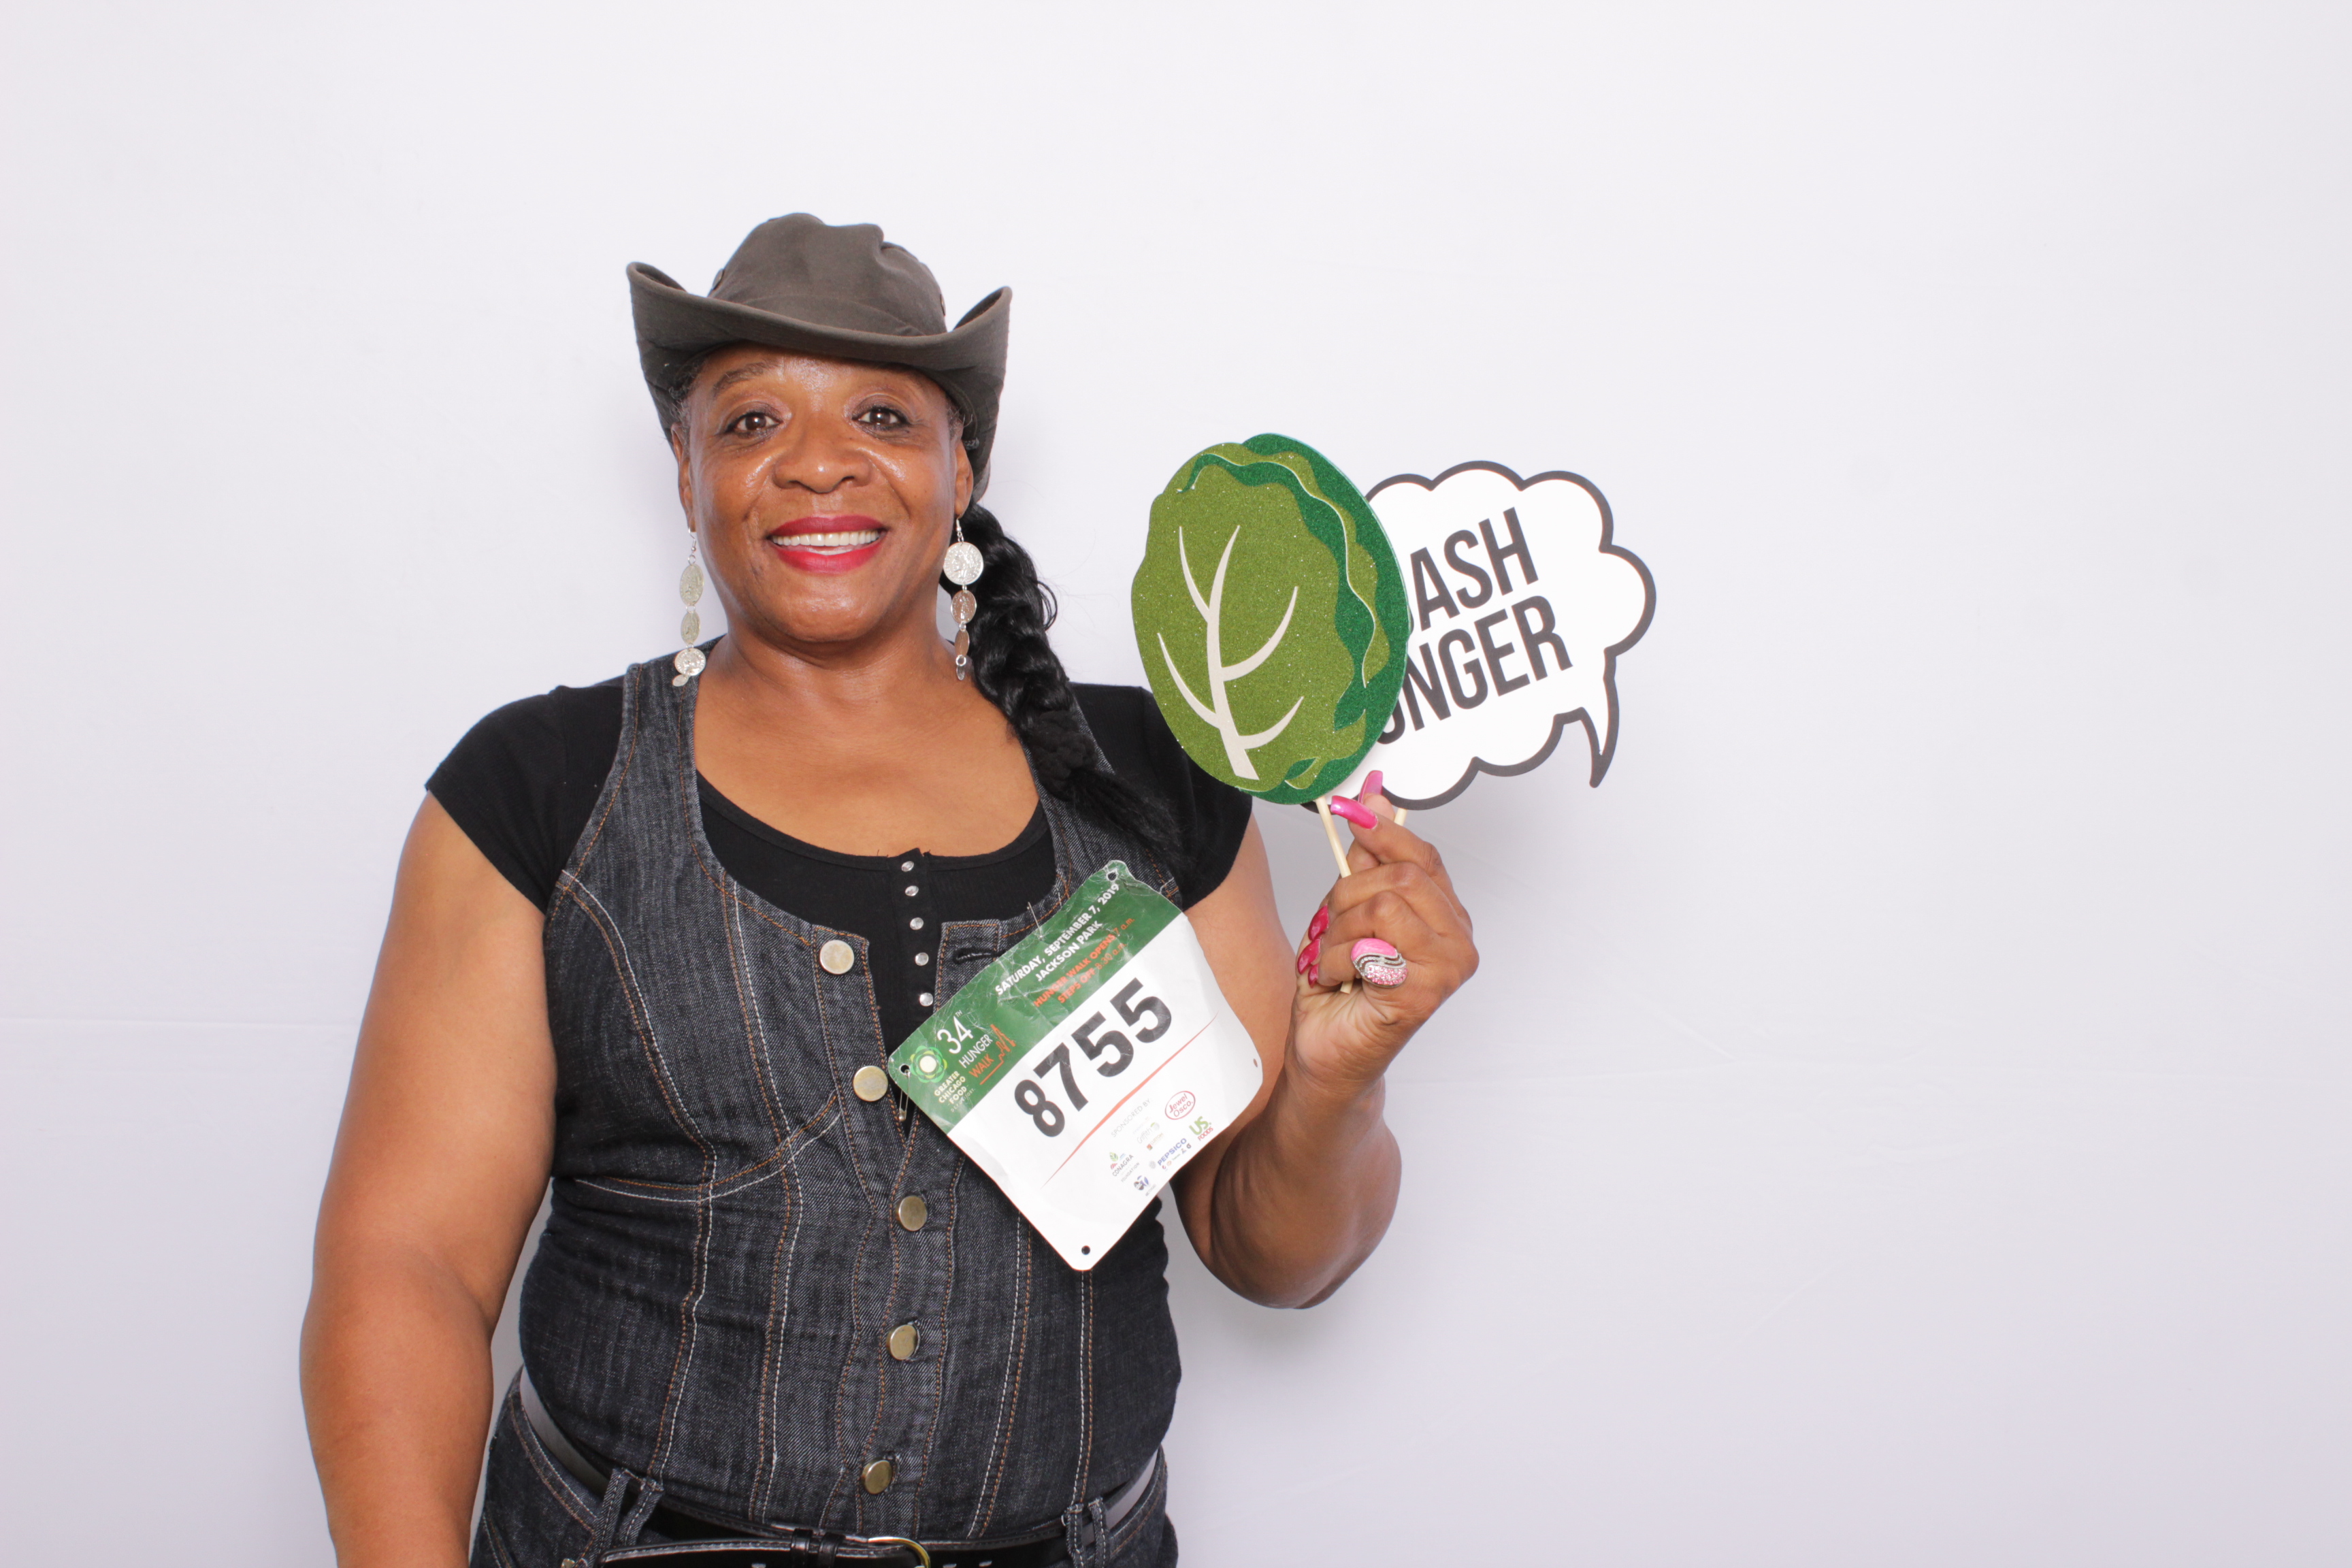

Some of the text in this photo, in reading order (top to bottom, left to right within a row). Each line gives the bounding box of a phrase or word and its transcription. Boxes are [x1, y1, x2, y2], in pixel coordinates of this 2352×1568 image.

[1408, 507, 1539, 635] ASH
[995, 883, 1120, 995] SATURDAY, SEPTEMBER 7, 2019
[1035, 920, 1102, 981] JACKSON PARK
[1033, 976, 1068, 1007] HUNGER
[1066, 958, 1092, 977] WALK
[1090, 934, 1116, 960] OPENS
[1121, 917, 1135, 930] a.m.
[1058, 983, 1082, 1004] STEPS
[1080, 967, 1096, 983] OFF
[1094, 953, 1113, 970] 8:30
[959, 1034, 993, 1068] HUNGER
[1014, 977, 1172, 1138] 8755
[969, 1054, 994, 1078] WALK
[934, 1071, 960, 1096] GREATER
[938, 1076, 966, 1104] CHICAGO
[949, 1085, 967, 1105] FOOD
[1169, 1093, 1188, 1113] Jewel
[1111, 1106, 1143, 1138] SPONSORED
[1197, 1126, 1213, 1141] FOODS
[1112, 1154, 1134, 1177] CONAGRA
[1158, 1138, 1187, 1166] PEPSICO
[1121, 1162, 1141, 1183] FOUNDATION
